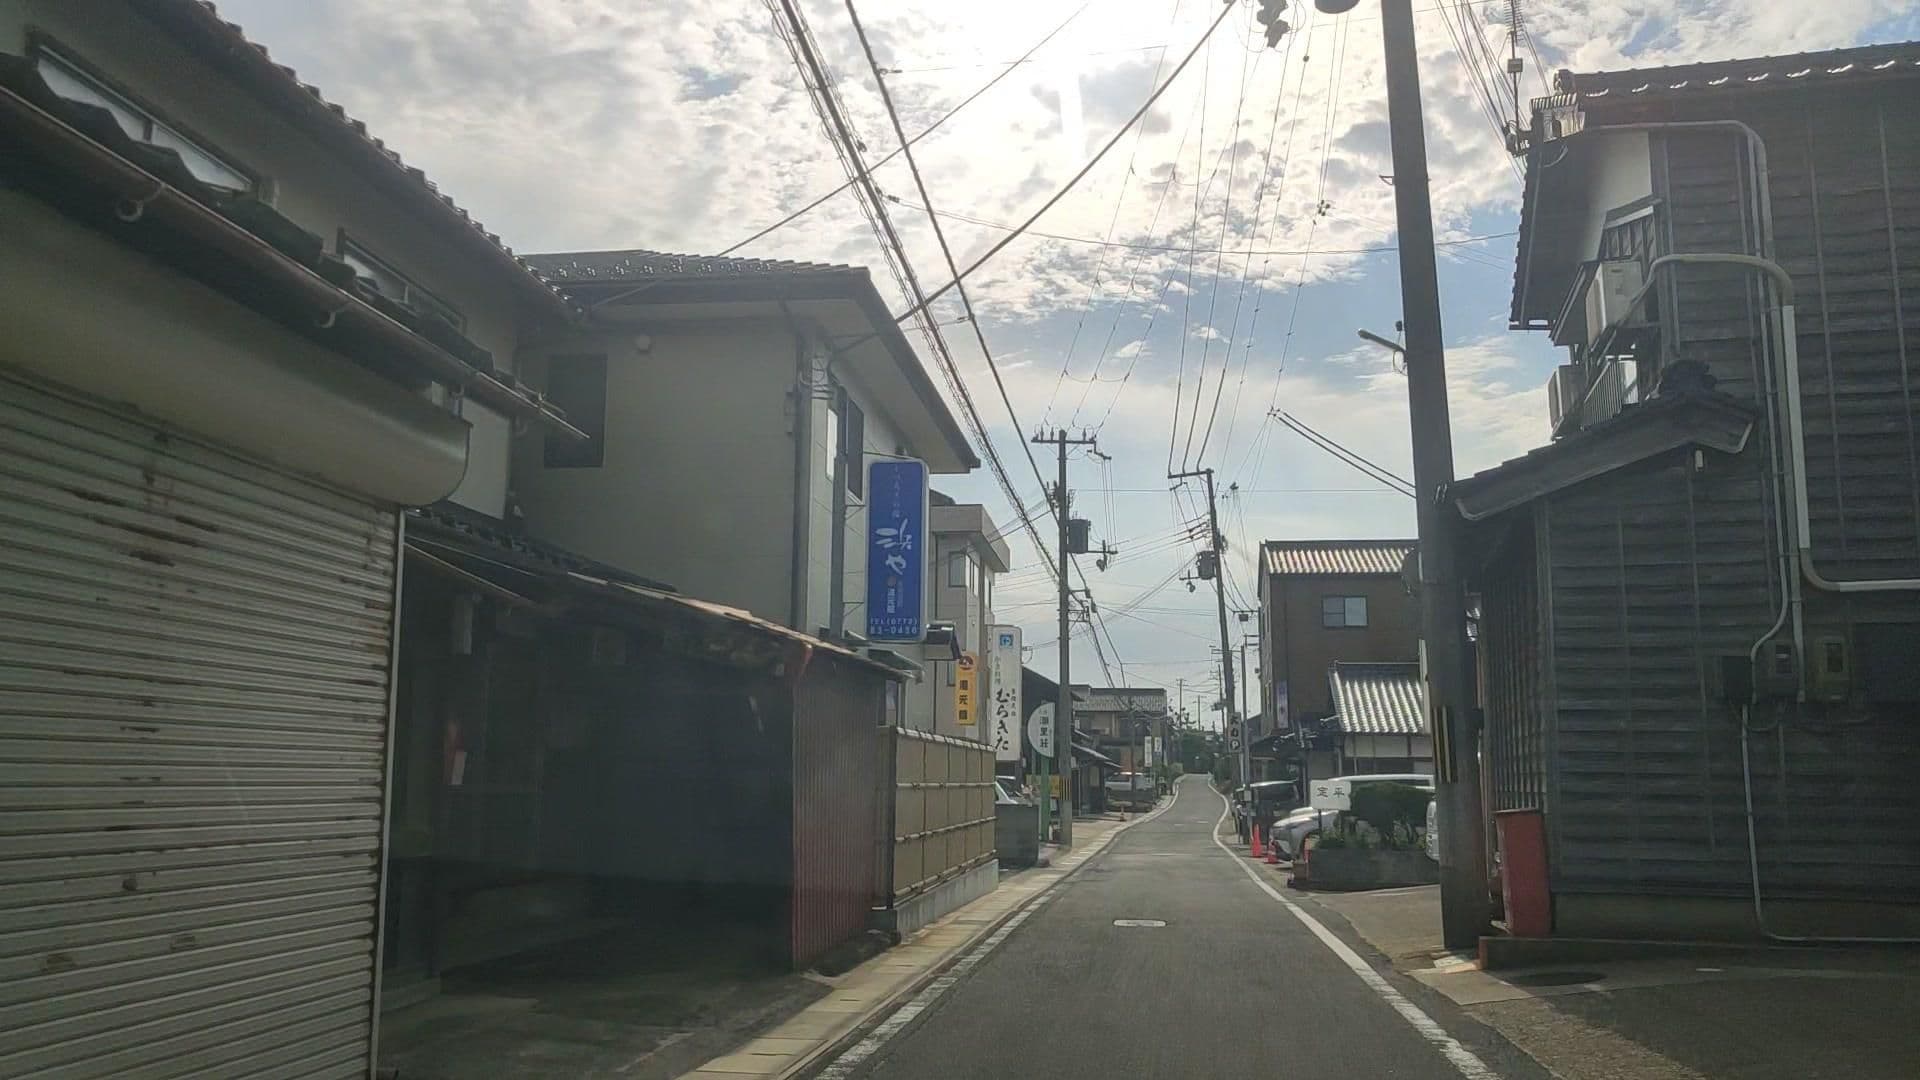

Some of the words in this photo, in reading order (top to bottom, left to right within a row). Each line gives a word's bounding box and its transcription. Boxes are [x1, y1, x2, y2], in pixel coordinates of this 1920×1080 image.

[994, 687, 1010, 750] むらきた
[1316, 786, 1345, 798] 定平
